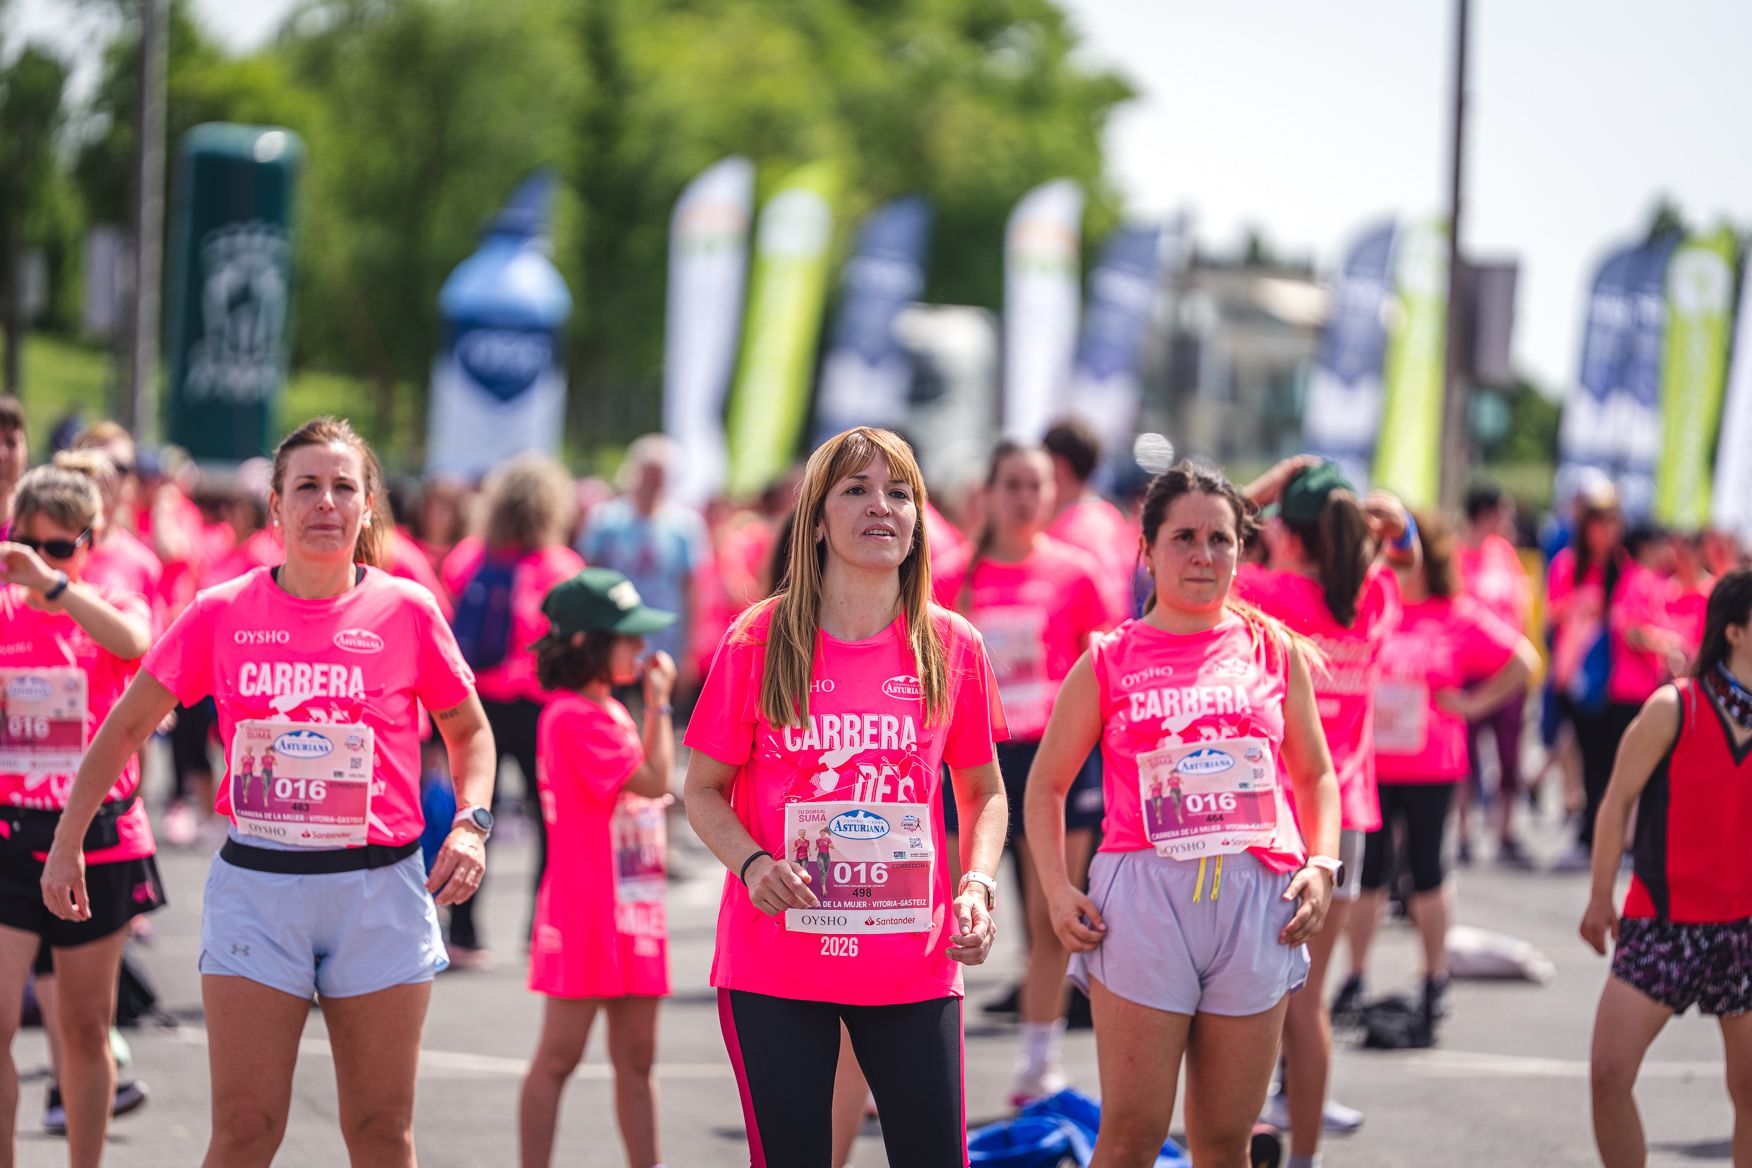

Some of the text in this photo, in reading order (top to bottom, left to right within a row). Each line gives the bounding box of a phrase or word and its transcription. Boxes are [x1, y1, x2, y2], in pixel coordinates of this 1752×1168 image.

[234, 630, 290, 645] OYSHO
[1121, 665, 1173, 687] OYSHO
[7, 716, 50, 739] 016
[279, 739, 330, 753] ASTURIANA
[274, 777, 327, 801] 016
[1186, 792, 1238, 813] 016
[799, 814, 827, 823] SUMA
[834, 819, 885, 833] ASTURIANA
[834, 862, 888, 884] 016
[852, 888, 872, 897] 498
[823, 901, 832, 909] DE
[833, 901, 842, 909] LA
[843, 901, 867, 909] MUJER
[872, 899, 927, 908] VITORIA-GASTEIZ
[801, 915, 848, 927] OYSHO
[876, 916, 916, 927] Santander
[820, 936, 859, 957] 2026
